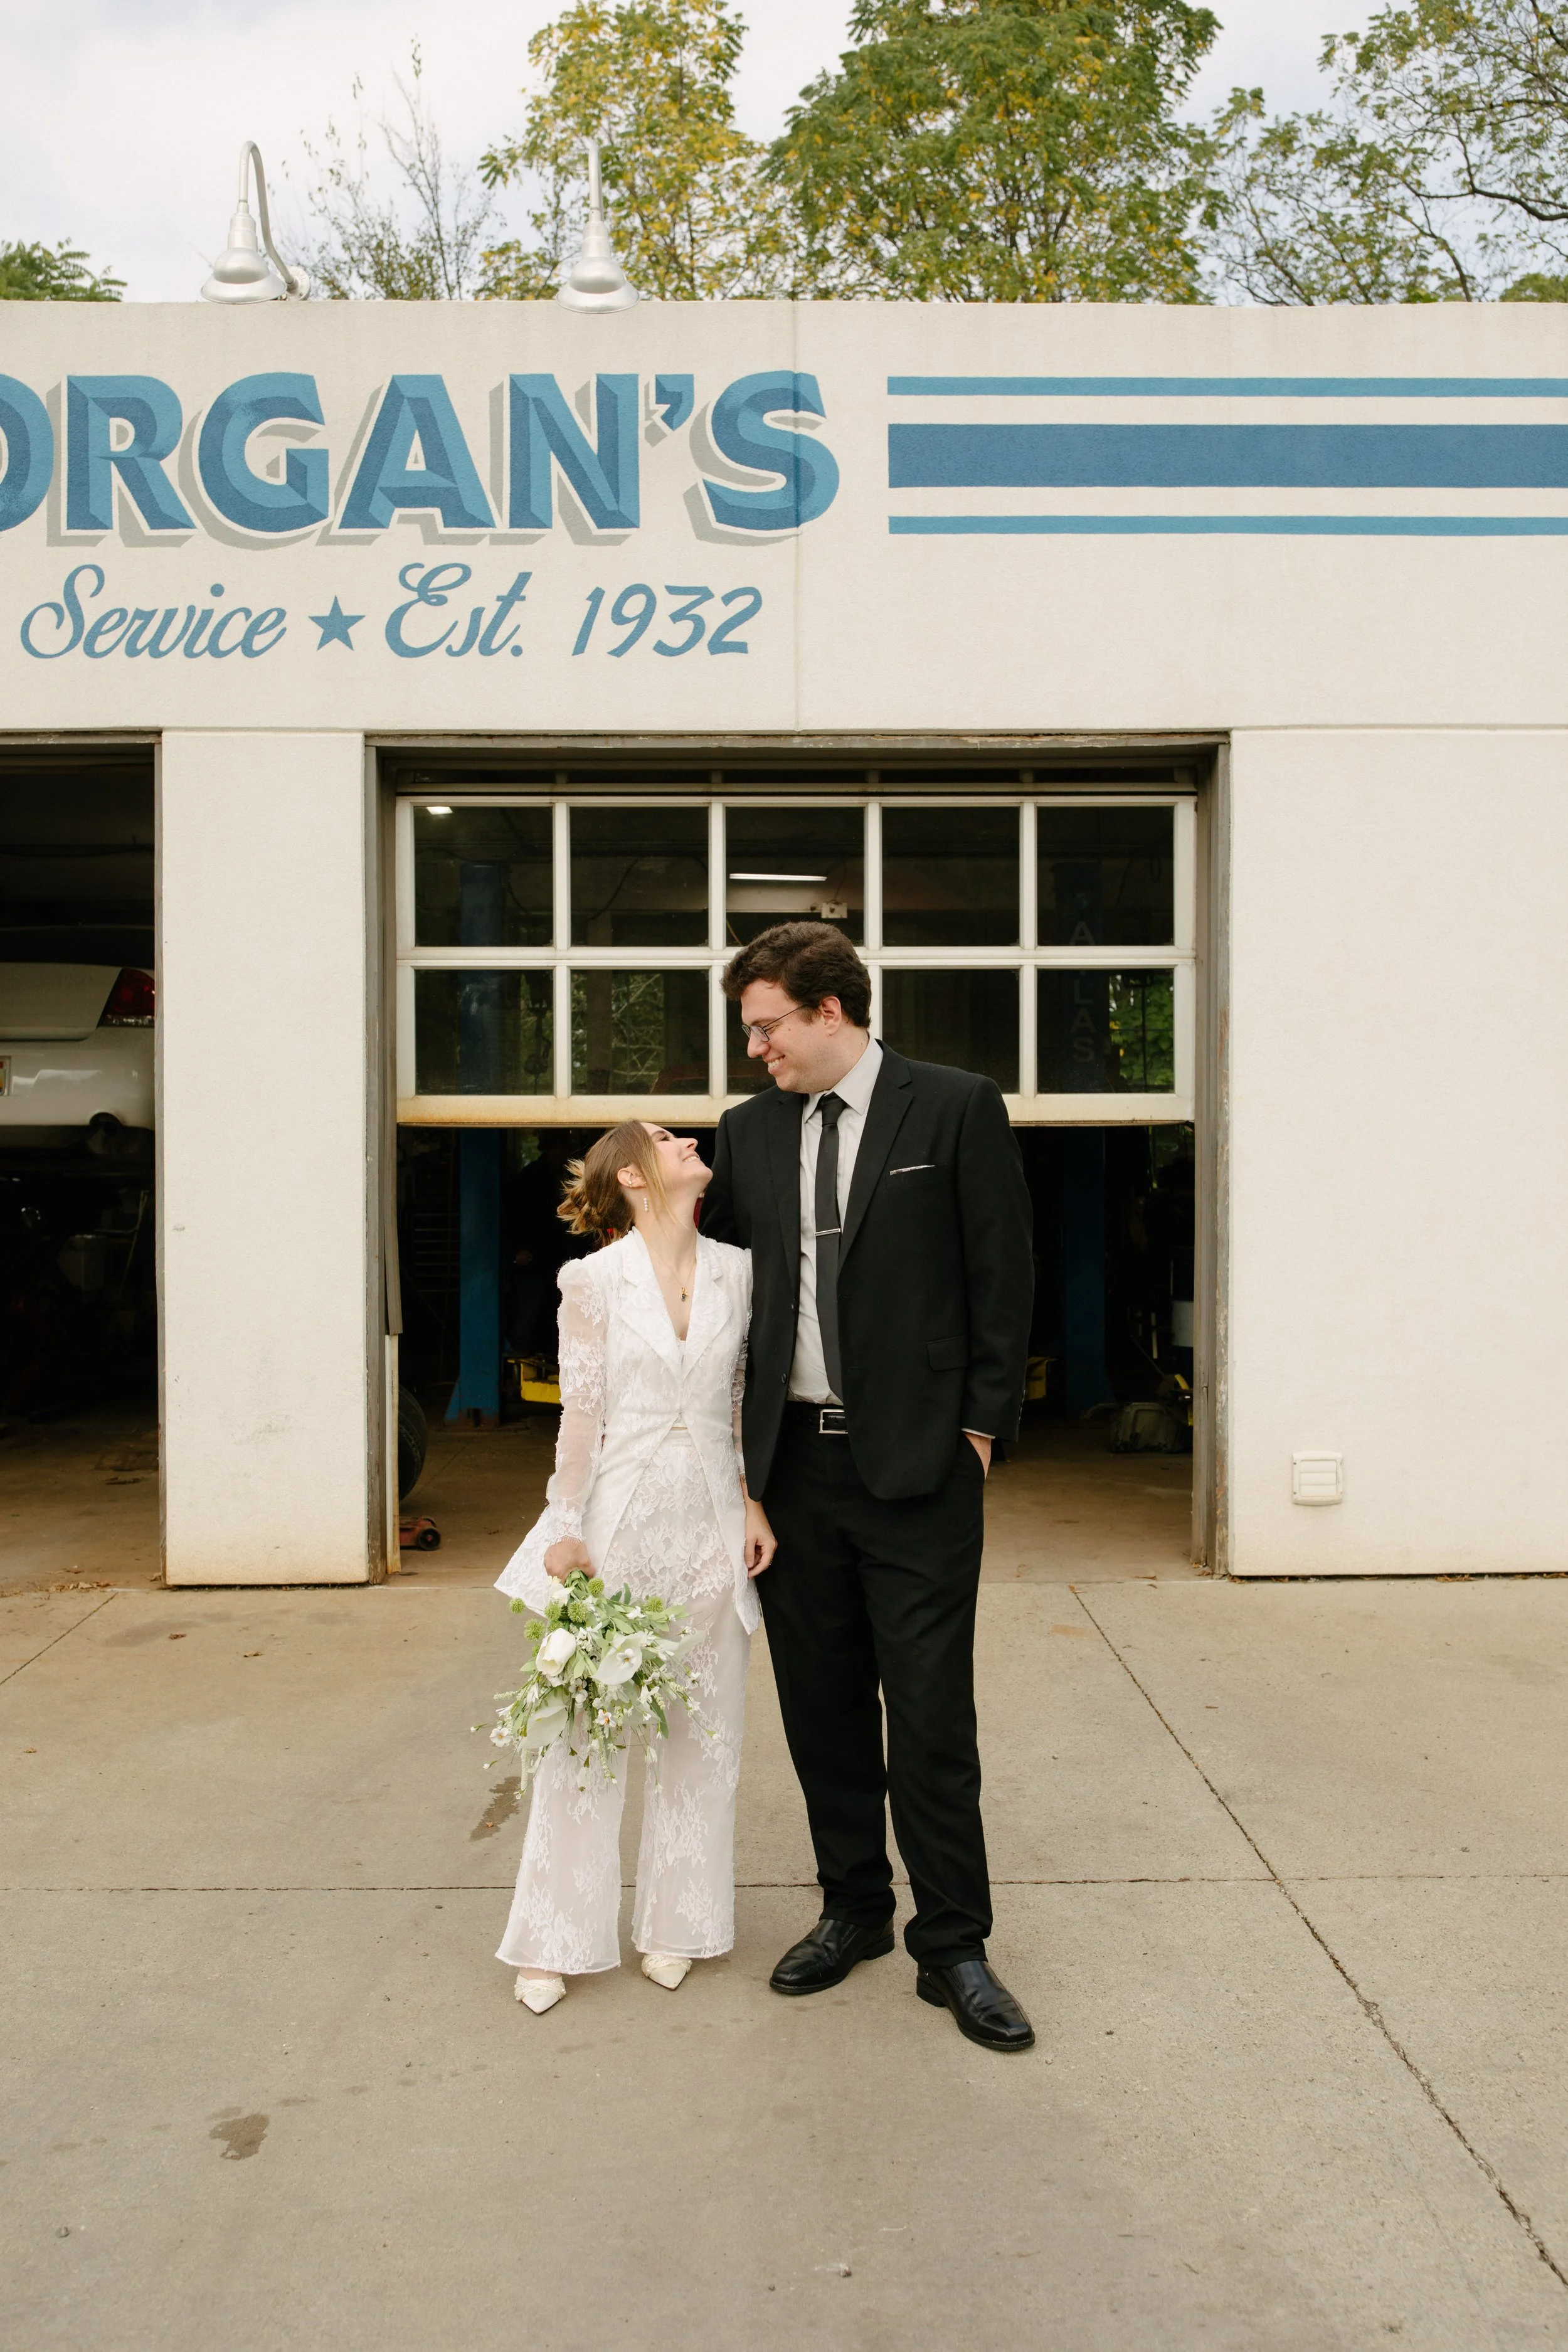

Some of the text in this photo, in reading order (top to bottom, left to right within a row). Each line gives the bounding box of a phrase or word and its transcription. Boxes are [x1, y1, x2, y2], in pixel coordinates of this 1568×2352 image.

[21, 563, 761, 659] Service Est. 1932
[1069, 921, 1097, 1062] ALAS
